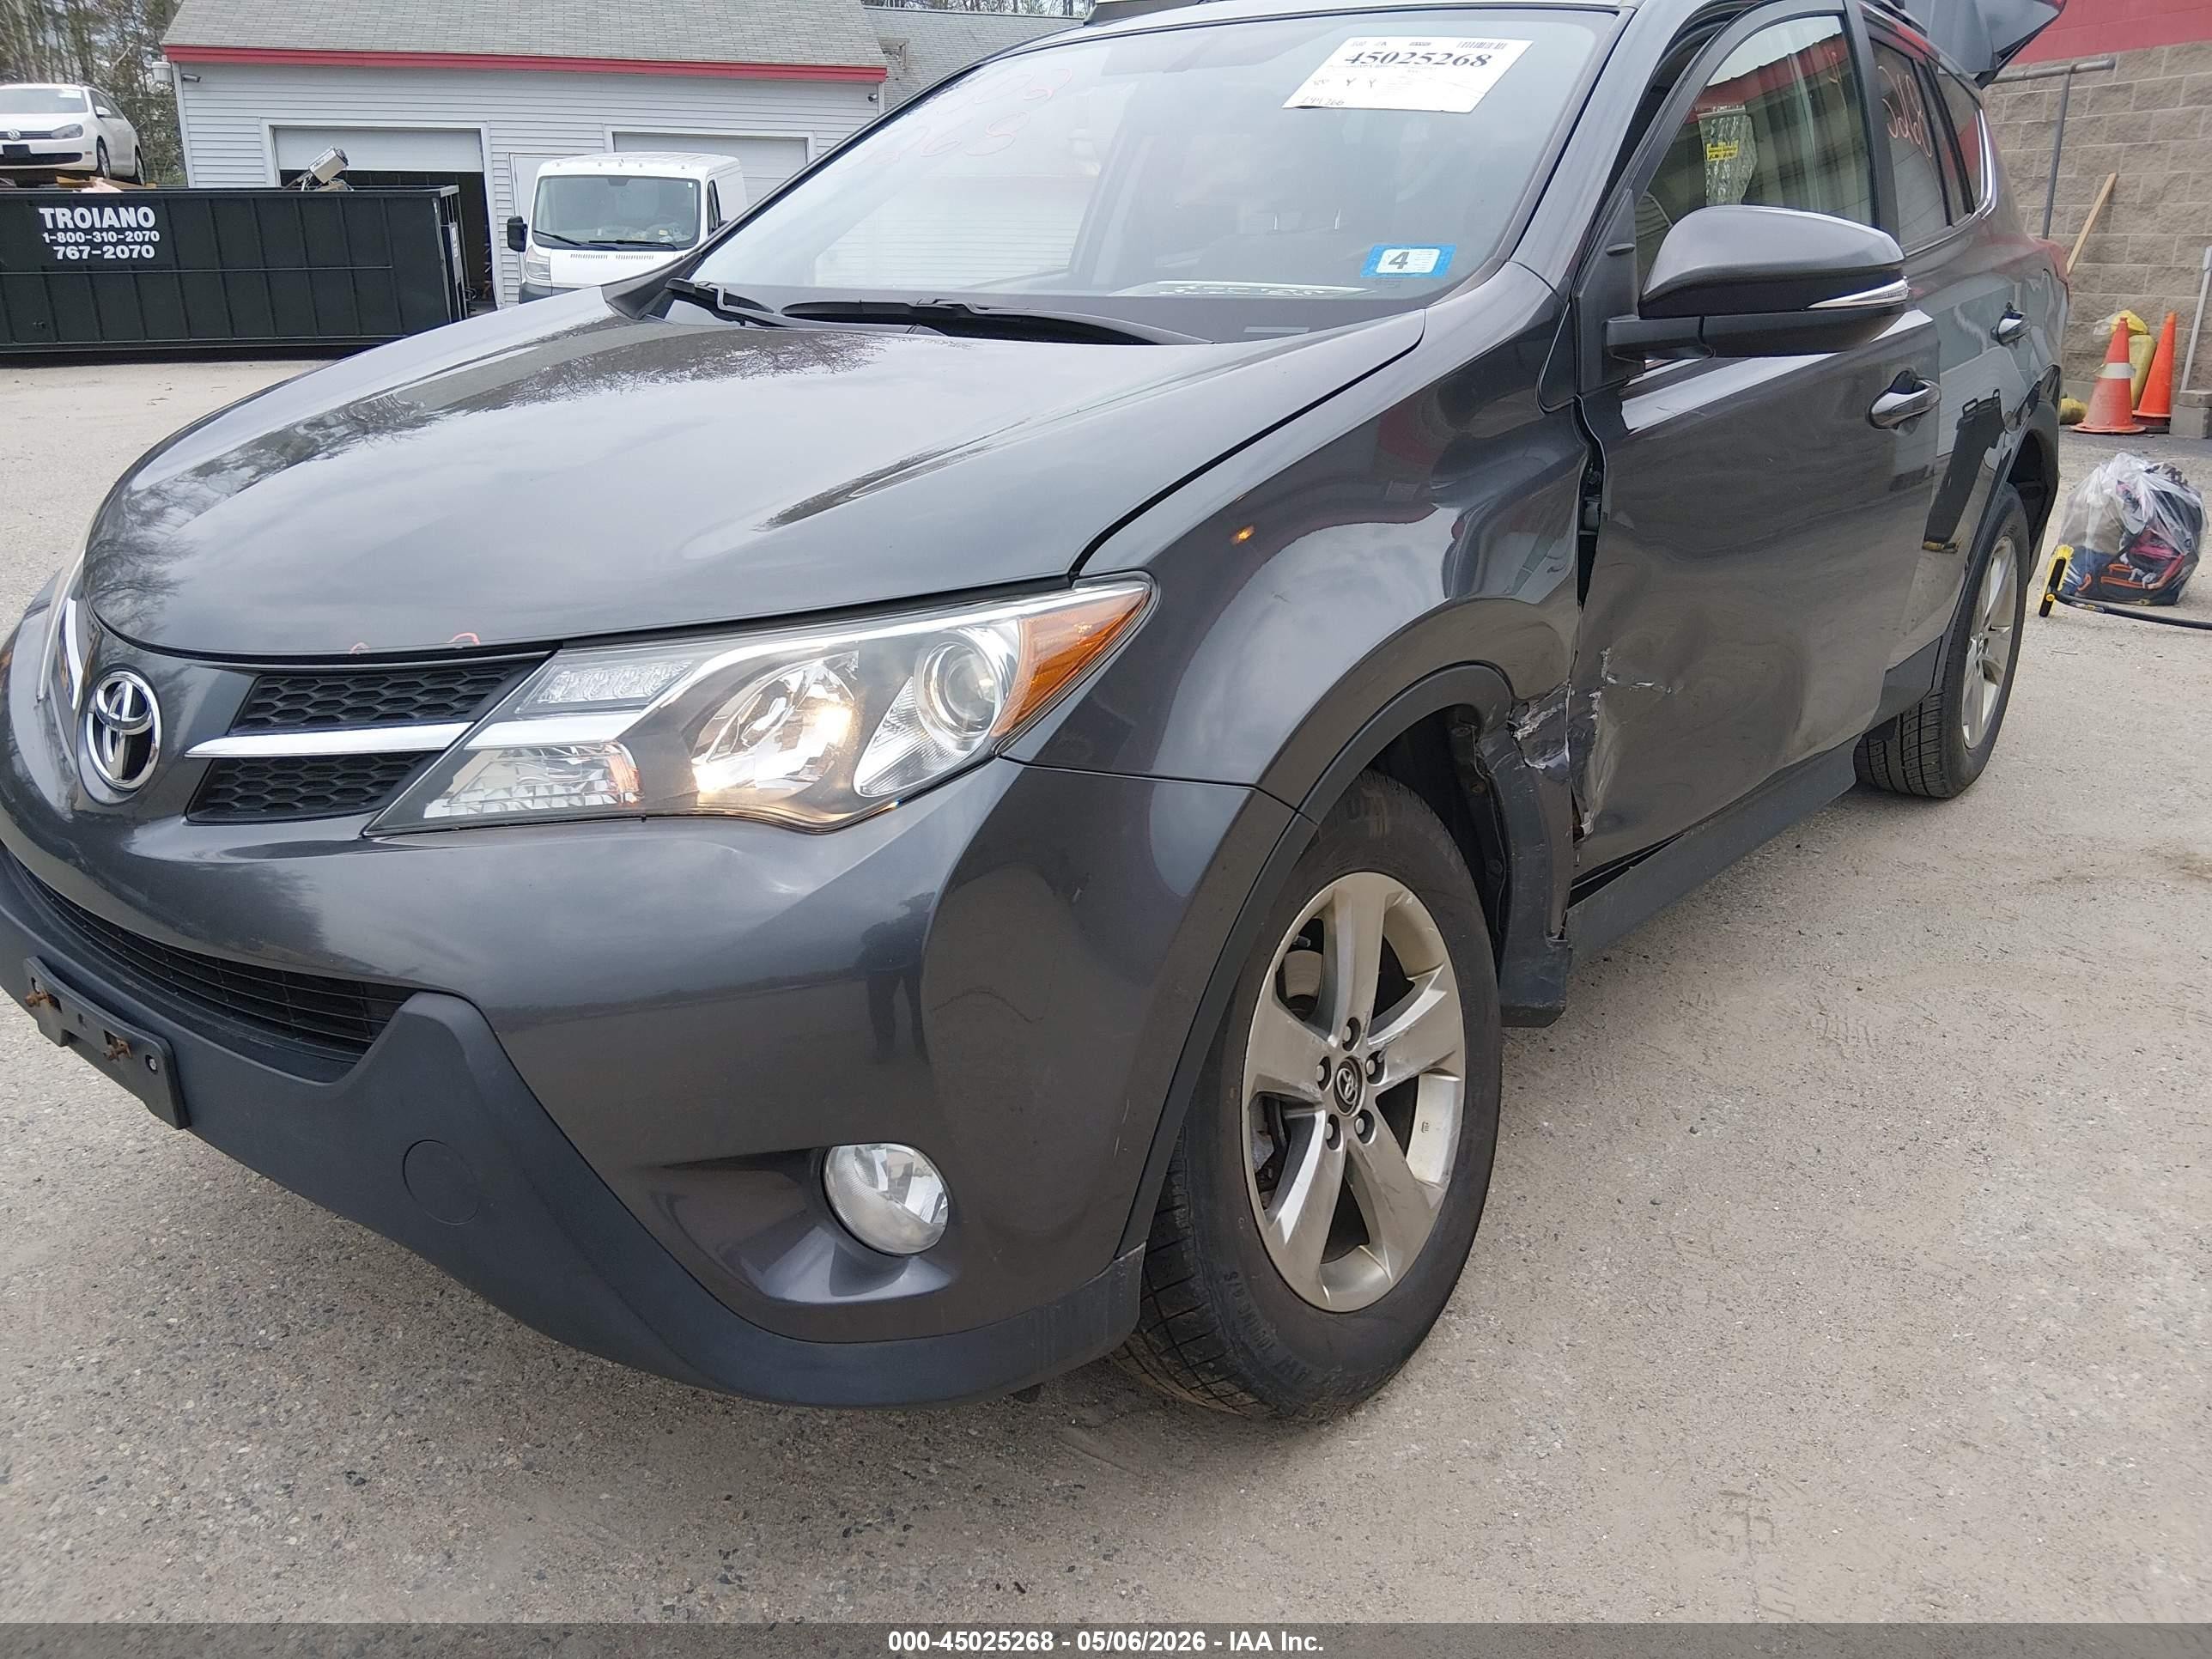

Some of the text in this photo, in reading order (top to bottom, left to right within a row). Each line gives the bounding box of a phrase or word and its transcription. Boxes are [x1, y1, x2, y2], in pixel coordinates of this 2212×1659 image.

[1345, 52, 1492, 68] 45025268
[39, 207, 155, 228] TROIANO
[43, 231, 161, 243] 1-800-310-2070
[52, 245, 155, 259] 767-2070
[1389, 252, 1410, 270] 4
